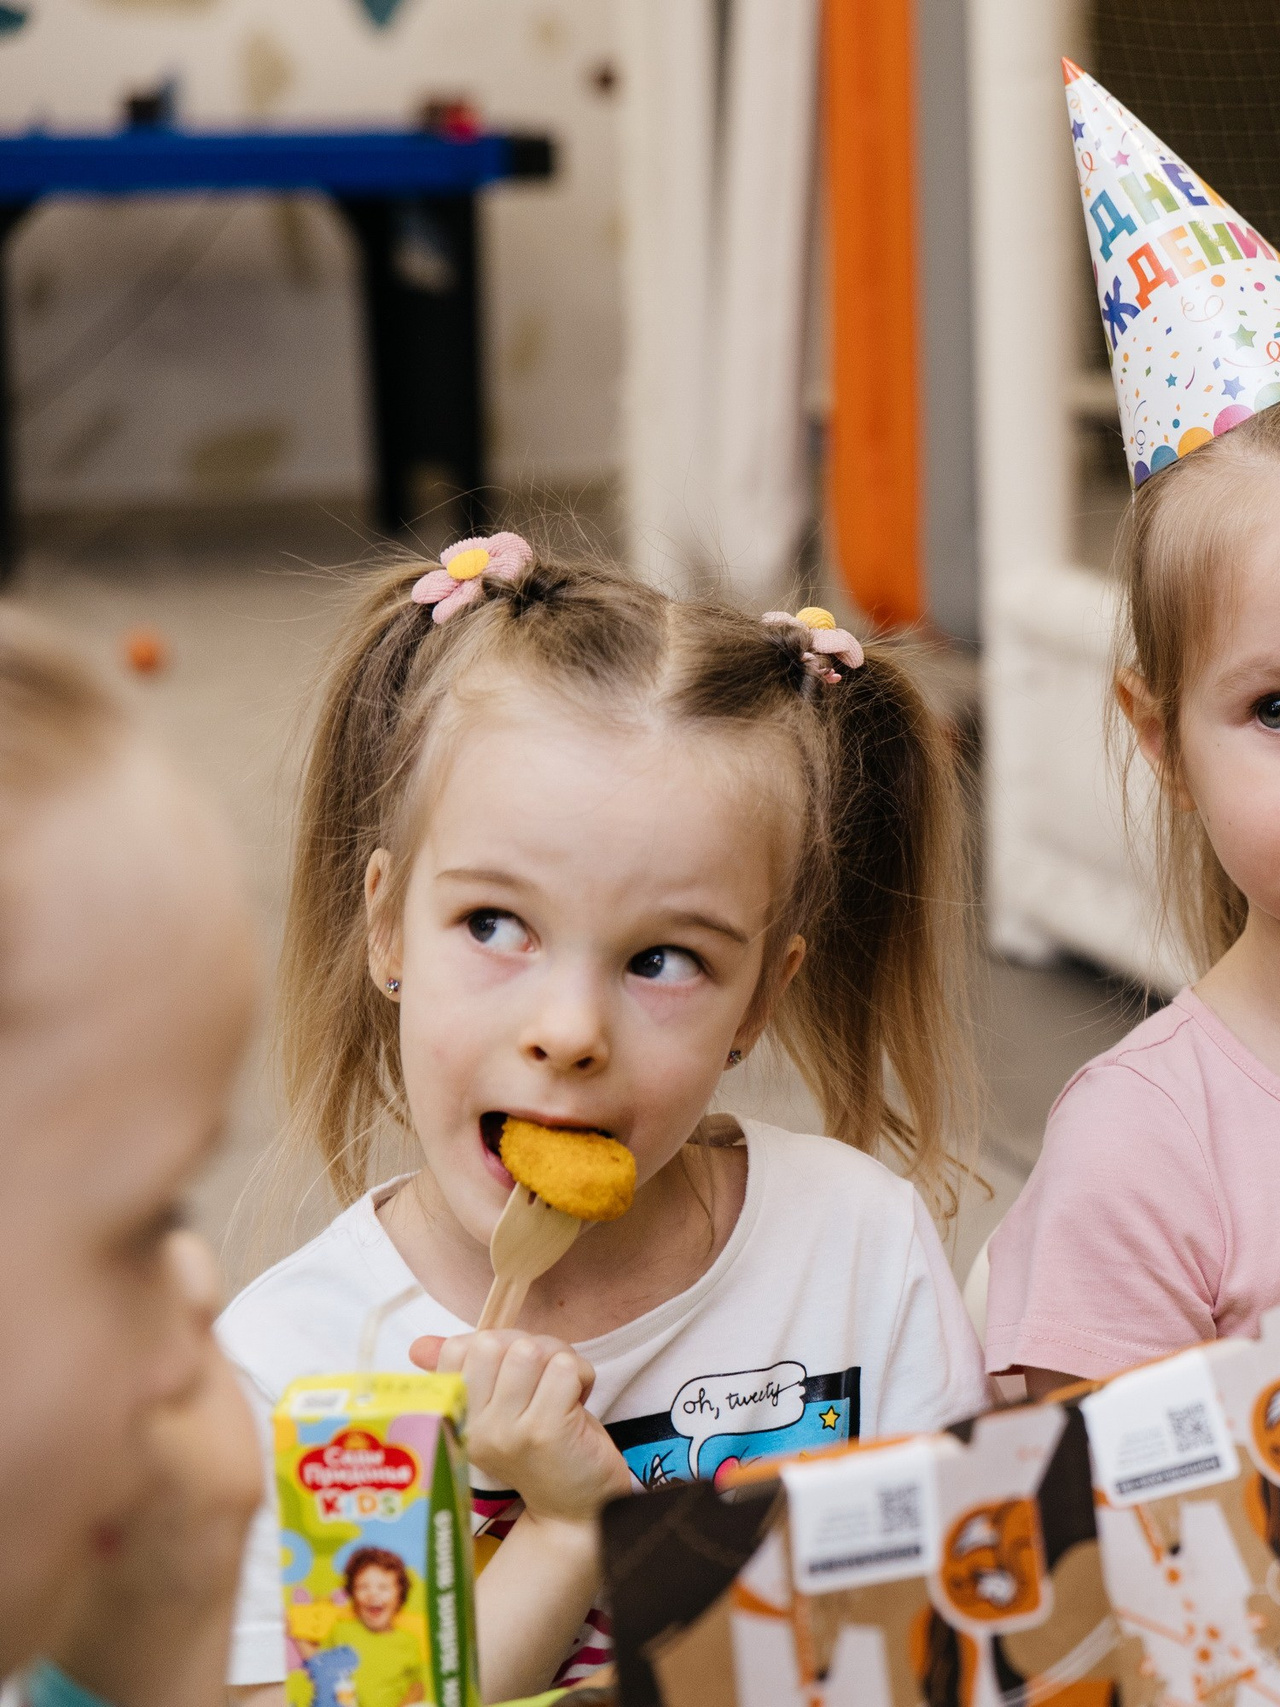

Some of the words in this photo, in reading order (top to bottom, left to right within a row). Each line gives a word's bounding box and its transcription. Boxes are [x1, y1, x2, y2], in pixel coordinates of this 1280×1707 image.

[1089, 163, 1227, 262] ДНЕ
[683, 1387, 720, 1419] oh,
[318, 1489, 400, 1519] KIDS
